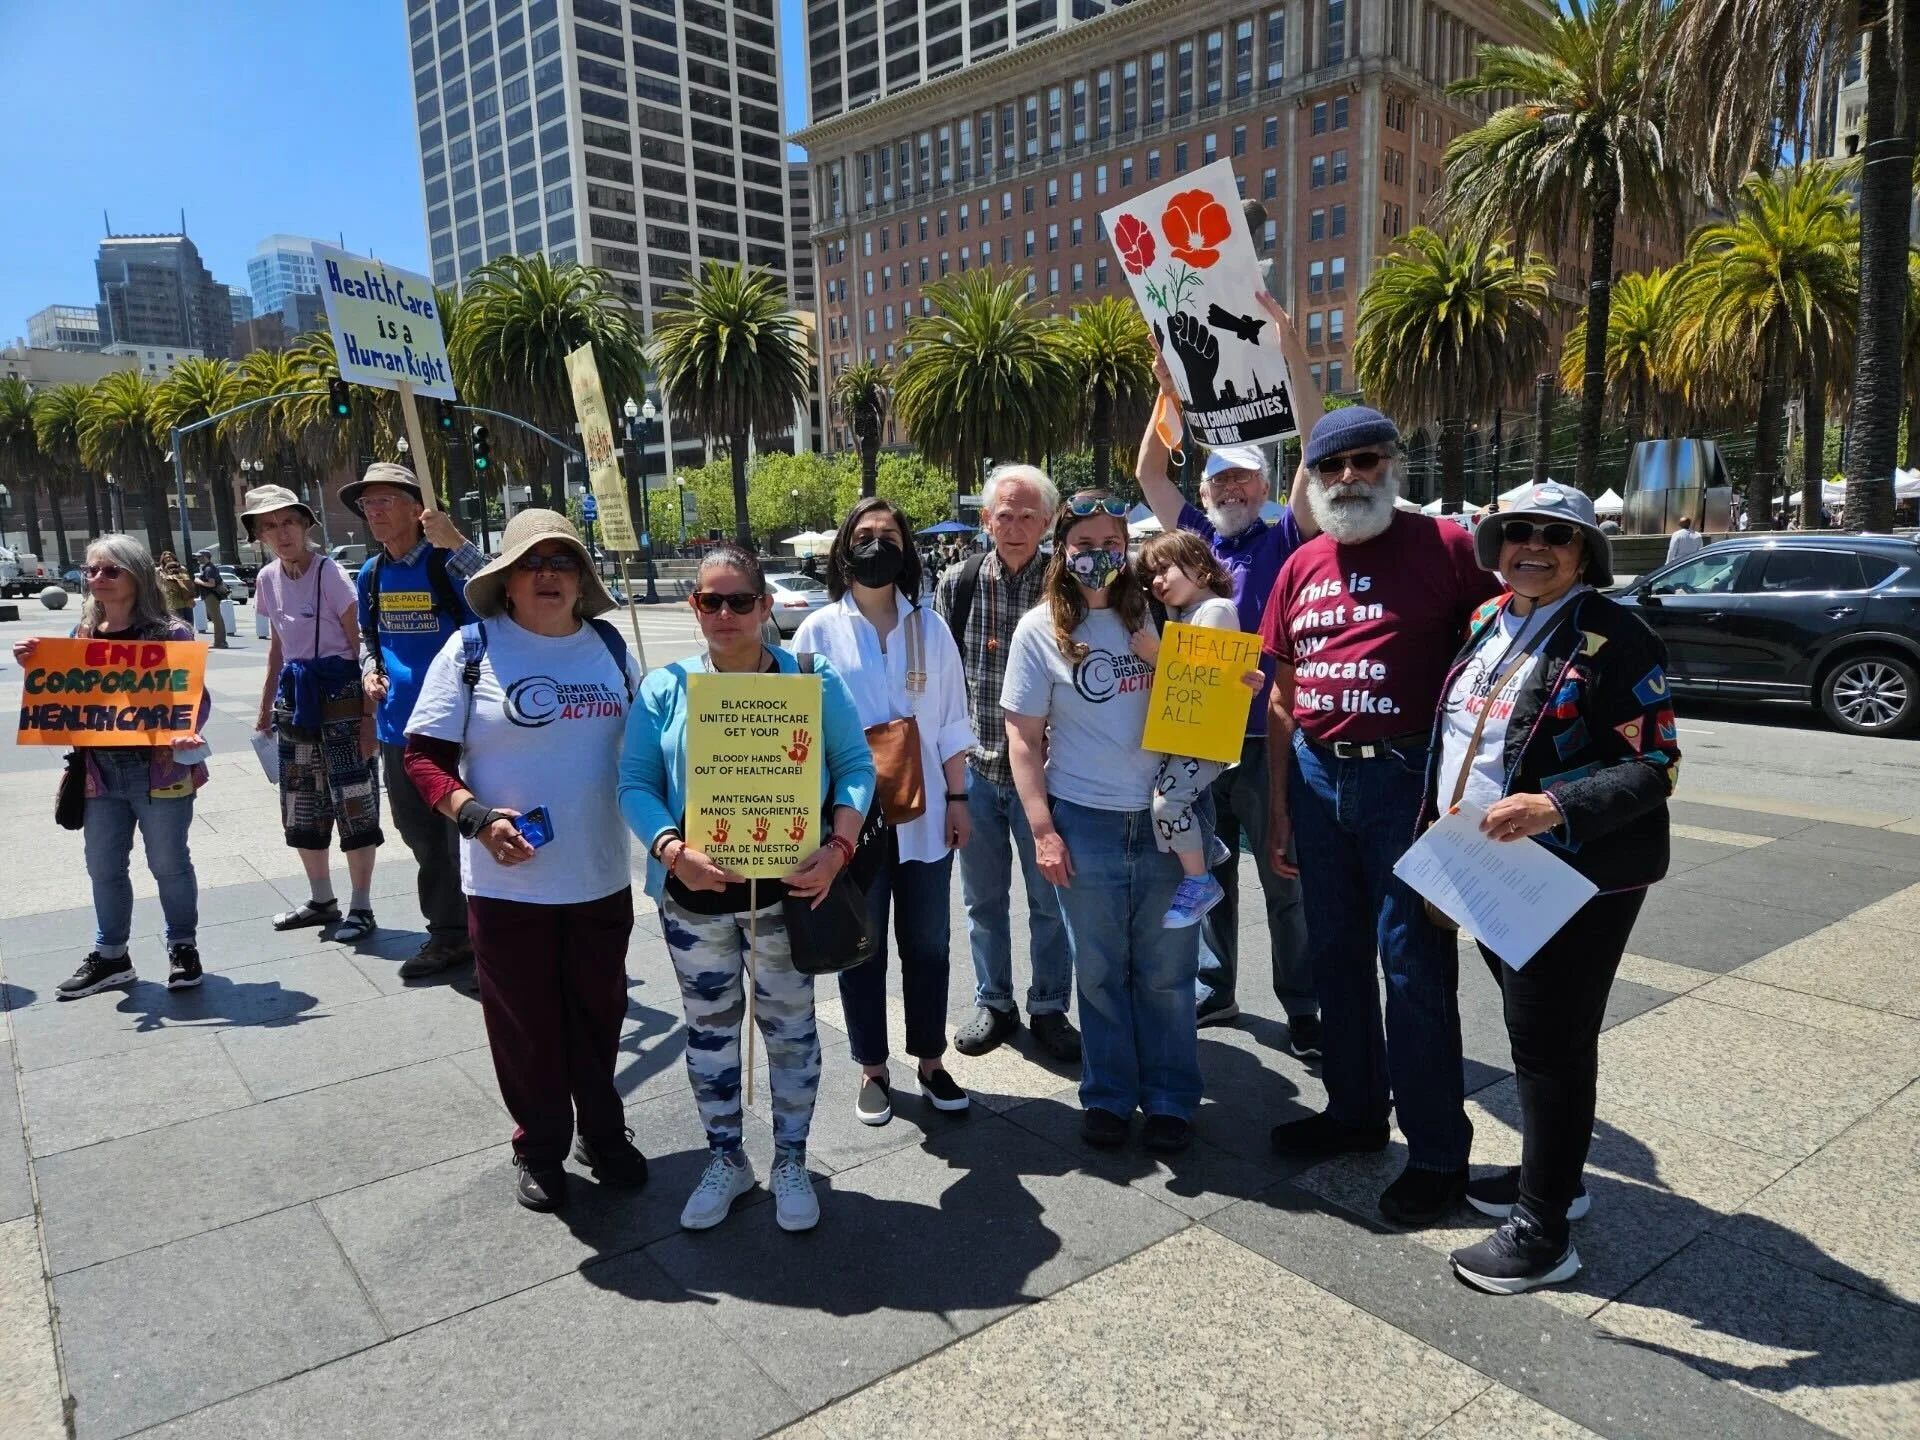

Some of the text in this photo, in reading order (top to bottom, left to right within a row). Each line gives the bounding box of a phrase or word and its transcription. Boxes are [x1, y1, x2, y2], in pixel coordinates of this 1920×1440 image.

[325, 259, 434, 319] Health Care
[377, 315, 413, 344] is a
[344, 333, 446, 386] Human Right
[1207, 396, 1288, 427] COMMUNITIES,
[1217, 425, 1242, 444] WAR
[1299, 573, 1371, 606] This is
[1292, 603, 1383, 633] what an
[85, 642, 166, 668] END
[1178, 631, 1259, 663] HEALTH
[1112, 663, 1154, 678] DISABIL
[1166, 661, 1221, 687] CARE
[24, 668, 190, 694] CORPORATE
[555, 683, 609, 693] SENIOR &
[1118, 673, 1154, 694] ACTI
[557, 692, 622, 704] DISABILITY
[721, 700, 787, 709] BLACKROCK
[1166, 686, 1202, 705] FOR
[1341, 689, 1400, 714] like.
[560, 702, 622, 719] ACTION
[1161, 705, 1201, 725] ALL
[1465, 695, 1513, 720] ACON
[19, 704, 193, 731] HEALTHCARE
[700, 714, 809, 724] UNITED HEALTHCARE
[724, 728, 779, 737] GET YOUR
[712, 754, 781, 763] BLOODY HANDS
[694, 766, 716, 775] OUT
[719, 766, 733, 775] OF
[712, 794, 795, 804] MANTENGAN SUS
[700, 807, 809, 816] MANOS SANGRIENTAS
[704, 844, 799, 853] FUERA DE NUESTRO
[712, 856, 798, 865] YSTEMA DE SALUD
